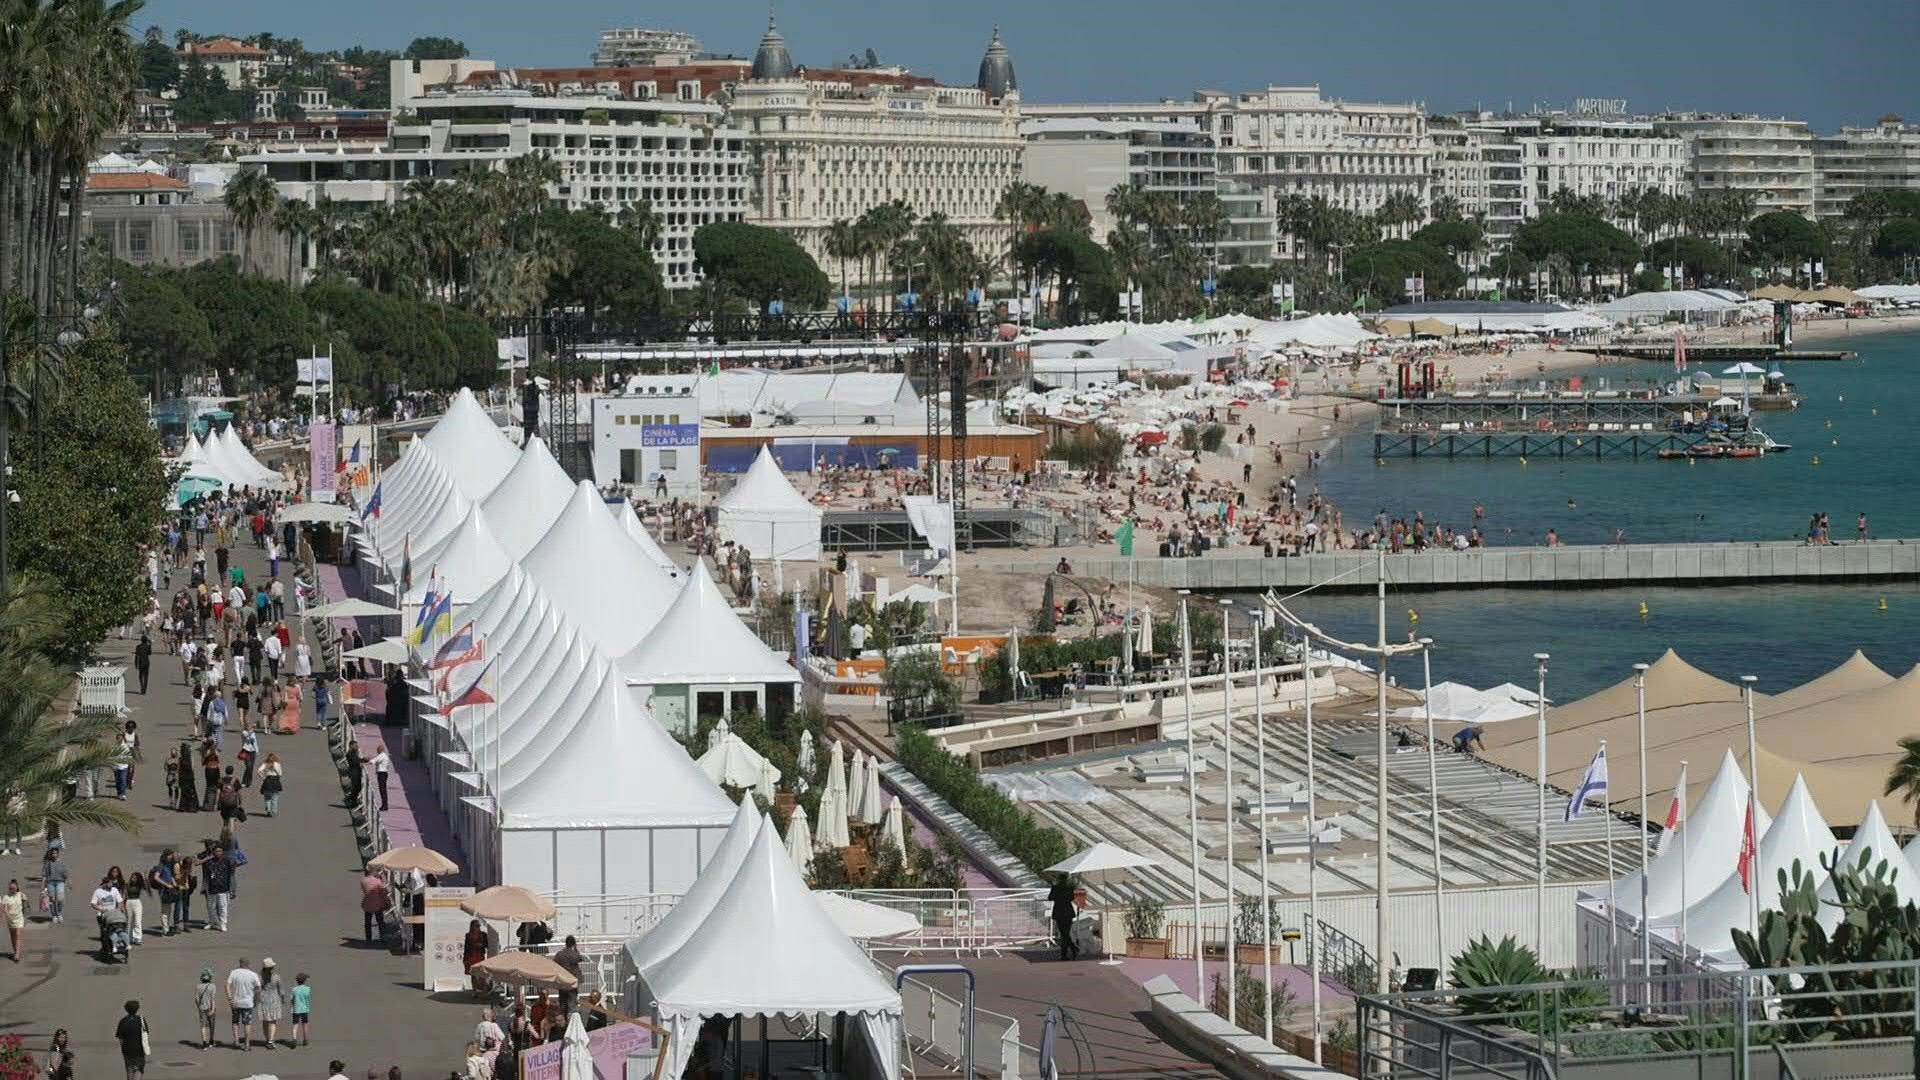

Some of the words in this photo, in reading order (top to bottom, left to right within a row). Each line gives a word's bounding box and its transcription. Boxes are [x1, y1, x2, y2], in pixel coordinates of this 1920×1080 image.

[1576, 98, 1626, 114] MARTINEZ
[643, 437, 656, 446] DE
[657, 437, 669, 446] LA
[670, 436, 698, 446] PLAGE
[527, 1048, 560, 1069] VILLAG
